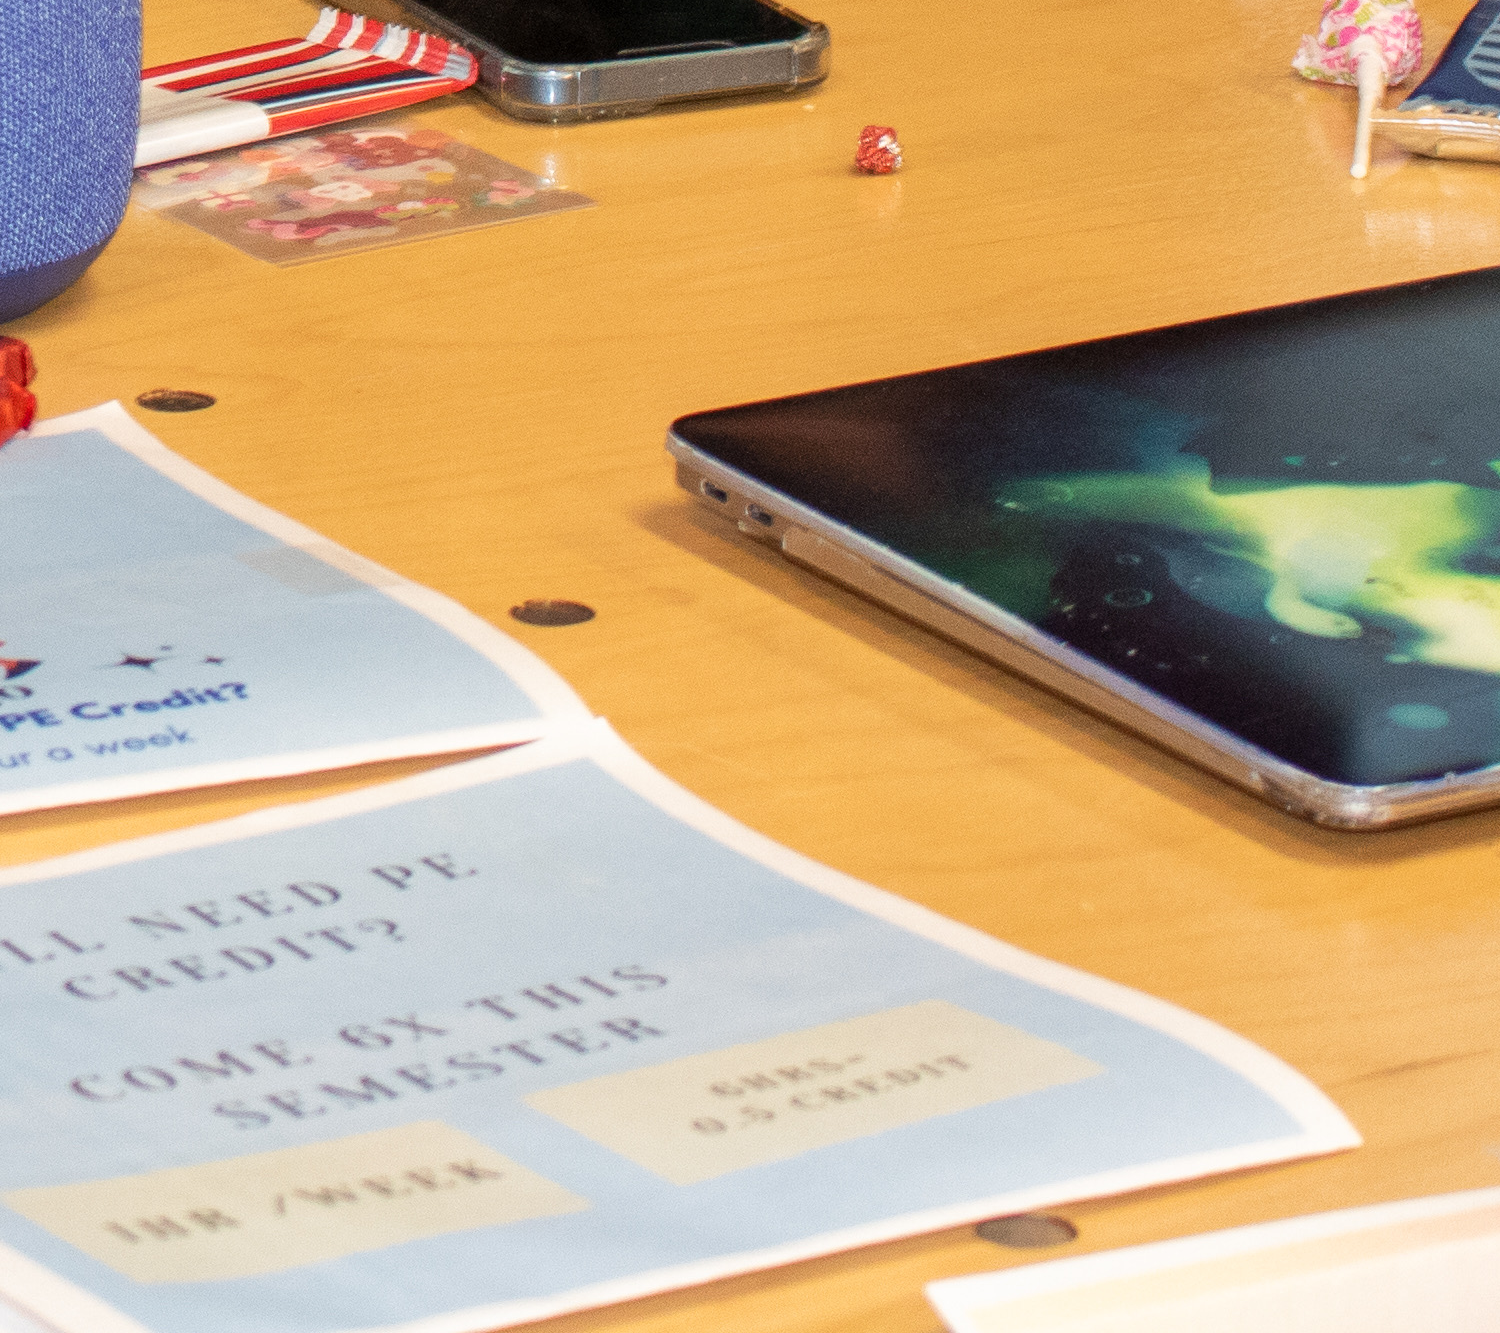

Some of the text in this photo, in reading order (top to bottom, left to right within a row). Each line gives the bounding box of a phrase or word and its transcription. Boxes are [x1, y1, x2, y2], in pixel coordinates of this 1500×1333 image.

[47, 743, 76, 763] a
[83, 725, 196, 757] week
[69, 680, 251, 722] Credit?
[126, 879, 344, 940] NEED
[371, 851, 480, 891] PE
[62, 915, 407, 1003] CREDIT?
[69, 963, 671, 1105] COME 6X THIS
[212, 1014, 668, 1130] SEMESTER
[788, 1053, 972, 1111] CREDIT
